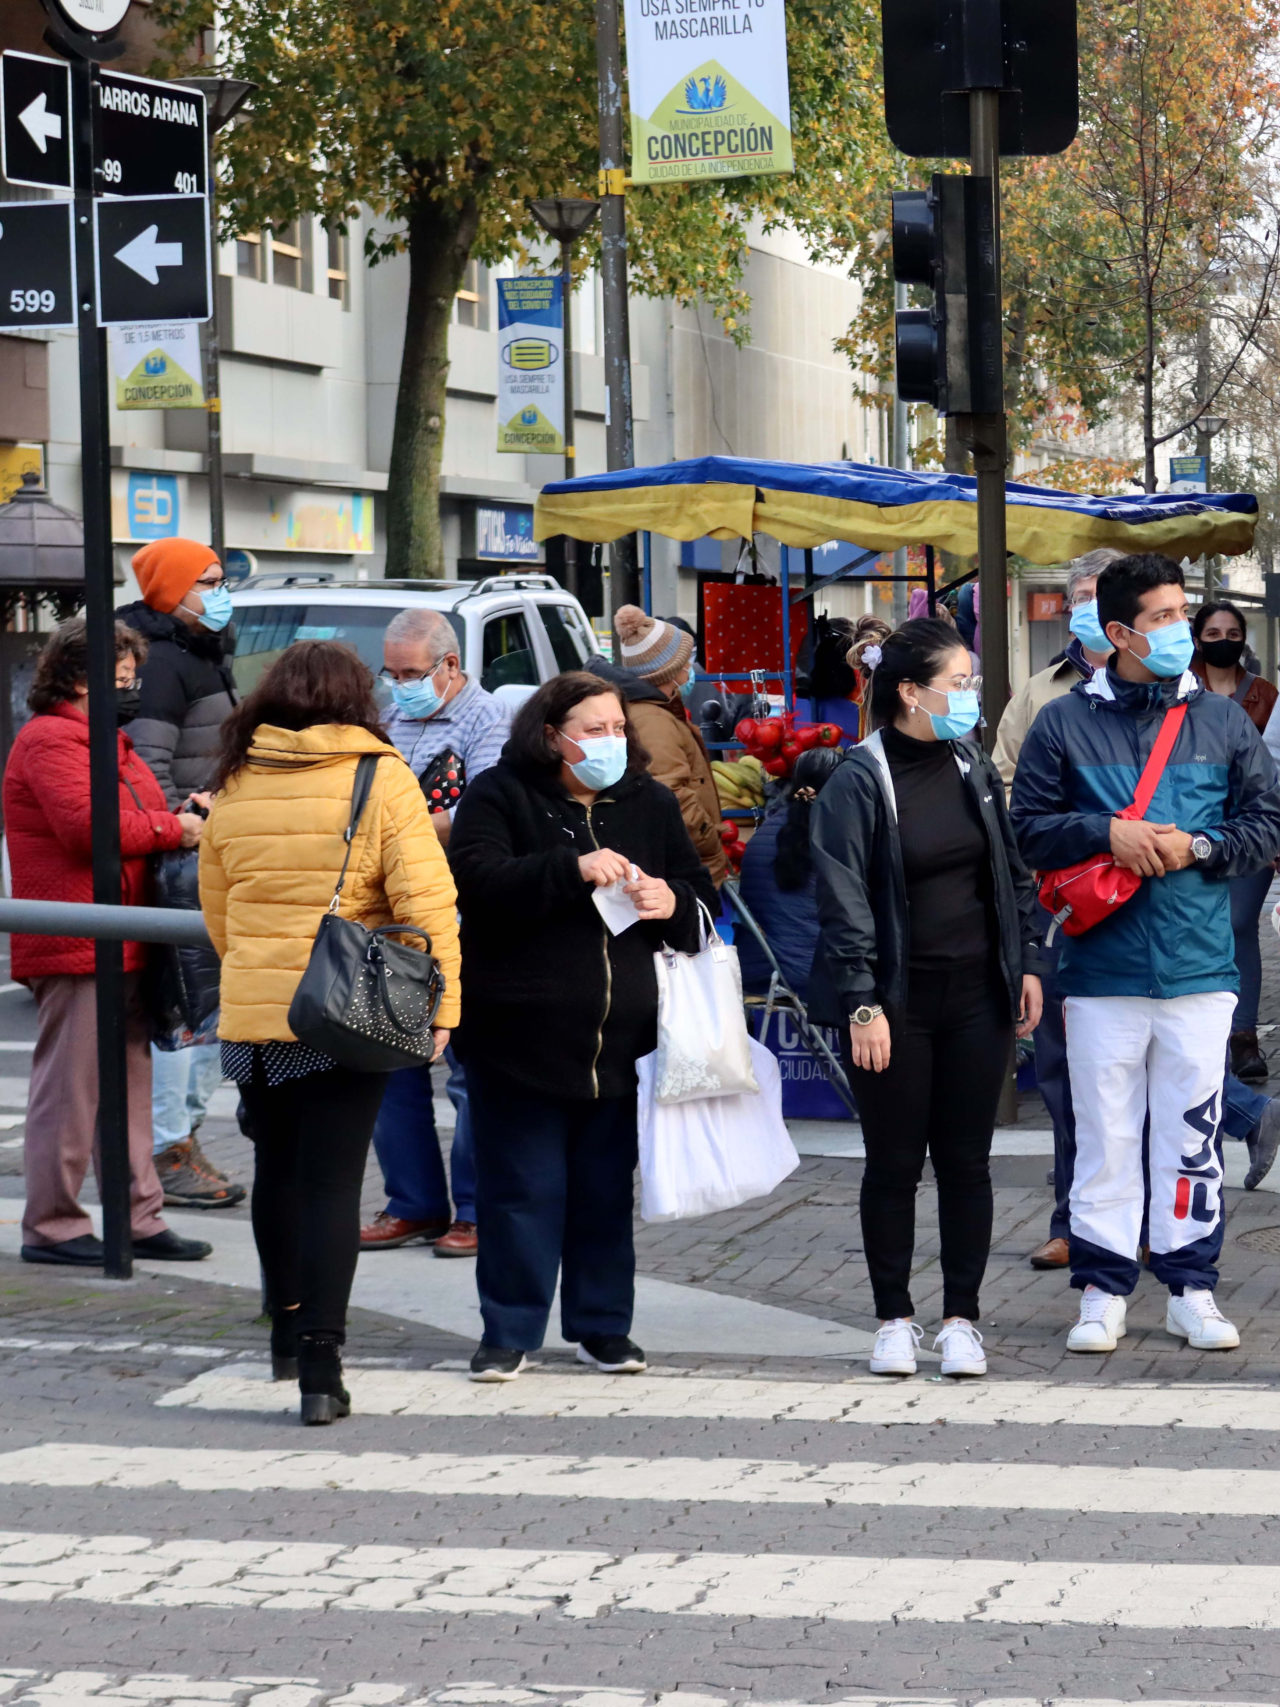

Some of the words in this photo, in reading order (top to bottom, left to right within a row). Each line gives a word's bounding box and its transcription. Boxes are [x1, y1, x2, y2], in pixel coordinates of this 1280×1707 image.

[640, 0, 671, 17] USA
[655, 14, 753, 41] MASCARILLA
[100, 86, 151, 118] ARROS
[153, 96, 198, 127] ARANA
[669, 114, 734, 131] MUNICIPALIDAD
[737, 113, 748, 127] DE
[647, 122, 773, 161] CONCEPCIÓN
[102, 158, 122, 184] 99
[174, 172, 198, 194] 401
[648, 164, 680, 179] CIUDAD
[682, 164, 693, 177] DE
[695, 162, 707, 175] LA
[708, 157, 775, 175] INDEPENDENCIA
[10, 289, 56, 313] 599
[1173, 1090, 1220, 1223] FILA
